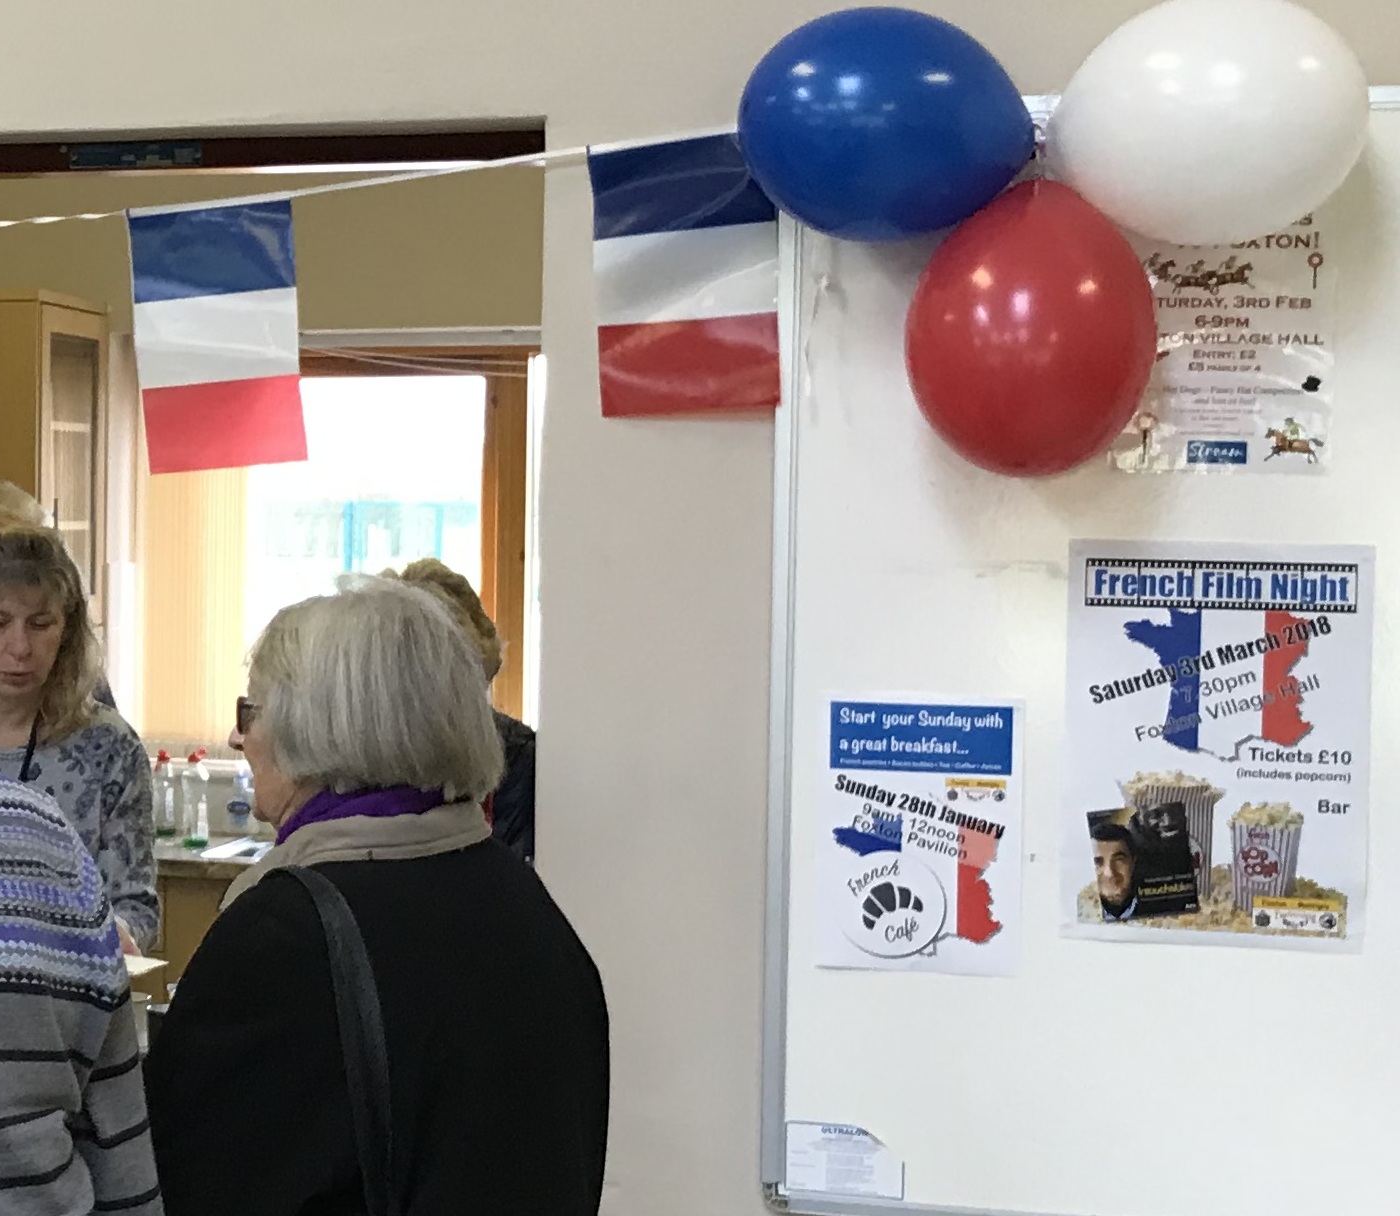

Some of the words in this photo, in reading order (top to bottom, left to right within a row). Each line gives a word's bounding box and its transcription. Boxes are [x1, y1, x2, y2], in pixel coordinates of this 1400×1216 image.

[1157, 297, 1228, 310] TURDAY,
[1233, 296, 1271, 309] 3RD
[1200, 332, 1273, 345] VILLAGE
[1278, 332, 1324, 345] HALL
[1094, 568, 1194, 598] French
[1202, 570, 1263, 600] Film
[1270, 573, 1350, 605] Night
[1089, 665, 1177, 705] Saturday
[1179, 653, 1216, 677] 3rd
[1218, 632, 1281, 667] March
[1283, 615, 1332, 645] 2018
[1205, 691, 1274, 720] Village
[1278, 674, 1321, 699] Hall
[839, 706, 875, 725] Start
[882, 713, 915, 730] your
[917, 709, 971, 732] Sunday
[974, 711, 1004, 729] with
[839, 738, 849, 751] a
[851, 737, 887, 755] great
[890, 735, 970, 755] breakfast...
[1248, 746, 1313, 764] Tickets
[1317, 749, 1353, 765] £10
[1236, 767, 1292, 780] (includes
[1294, 771, 1352, 784] popcorn)
[834, 773, 897, 808] Sunday
[897, 793, 937, 819] 28th
[938, 805, 1006, 840] January
[1317, 799, 1351, 814] Bar
[852, 814, 903, 839] Foxton
[907, 831, 968, 860] Pavilion
[909, 817, 966, 845] 12noon
[847, 858, 900, 898] French
[884, 916, 920, 943] Café
